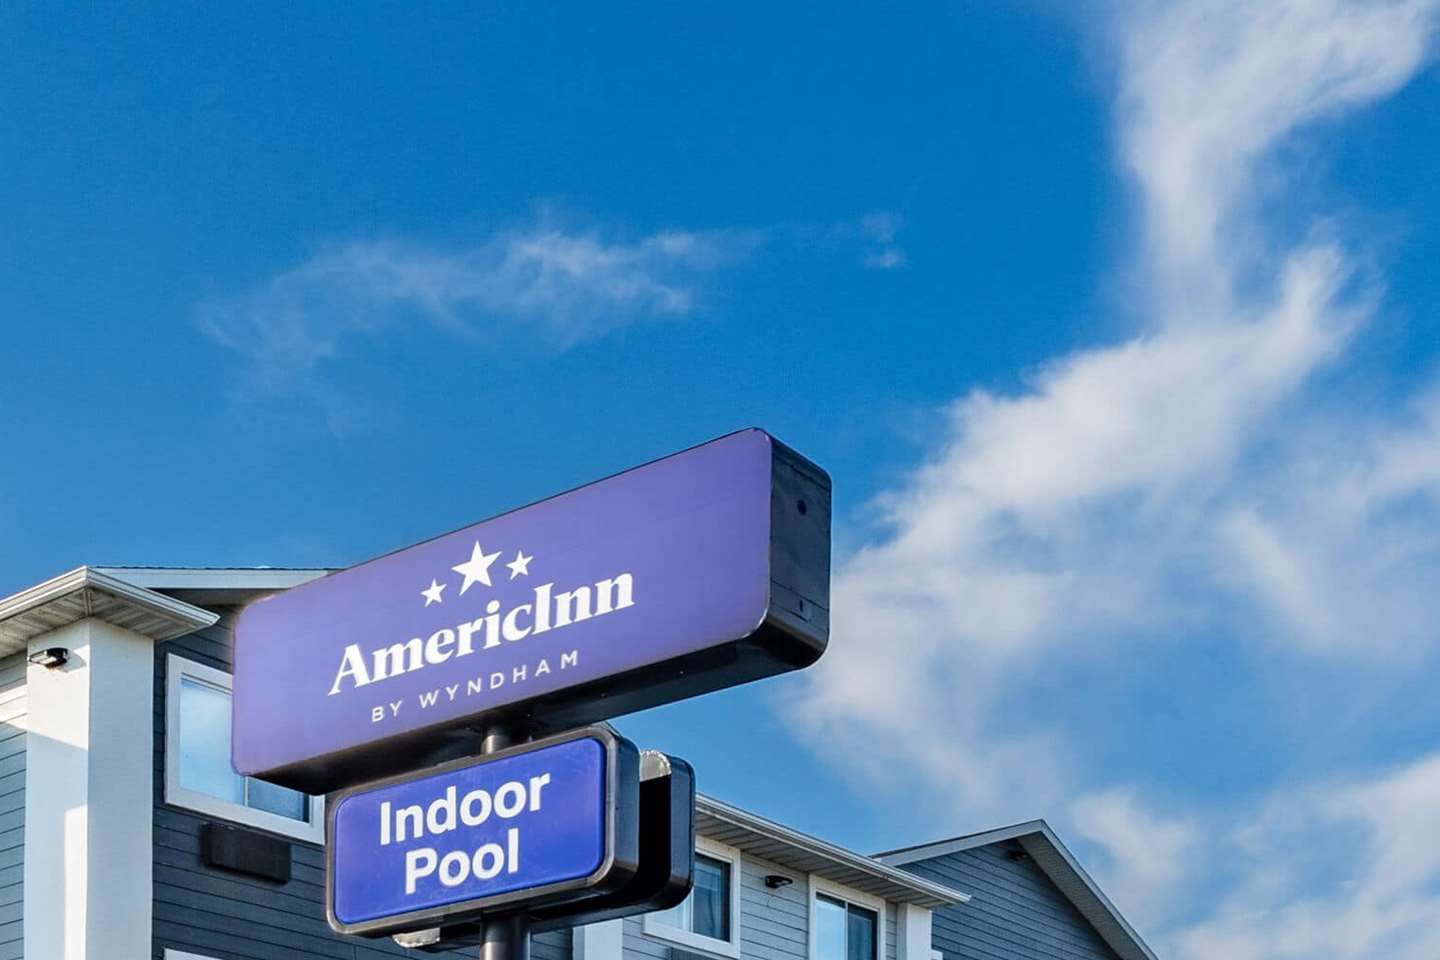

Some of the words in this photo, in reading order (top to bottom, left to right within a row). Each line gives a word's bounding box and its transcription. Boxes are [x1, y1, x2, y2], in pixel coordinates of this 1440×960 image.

[327, 573, 635, 696] AmericInn
[371, 700, 402, 722] BY
[419, 650, 579, 709] WYNDHAM
[379, 773, 550, 845] Indoor
[405, 828, 519, 894] Pool
